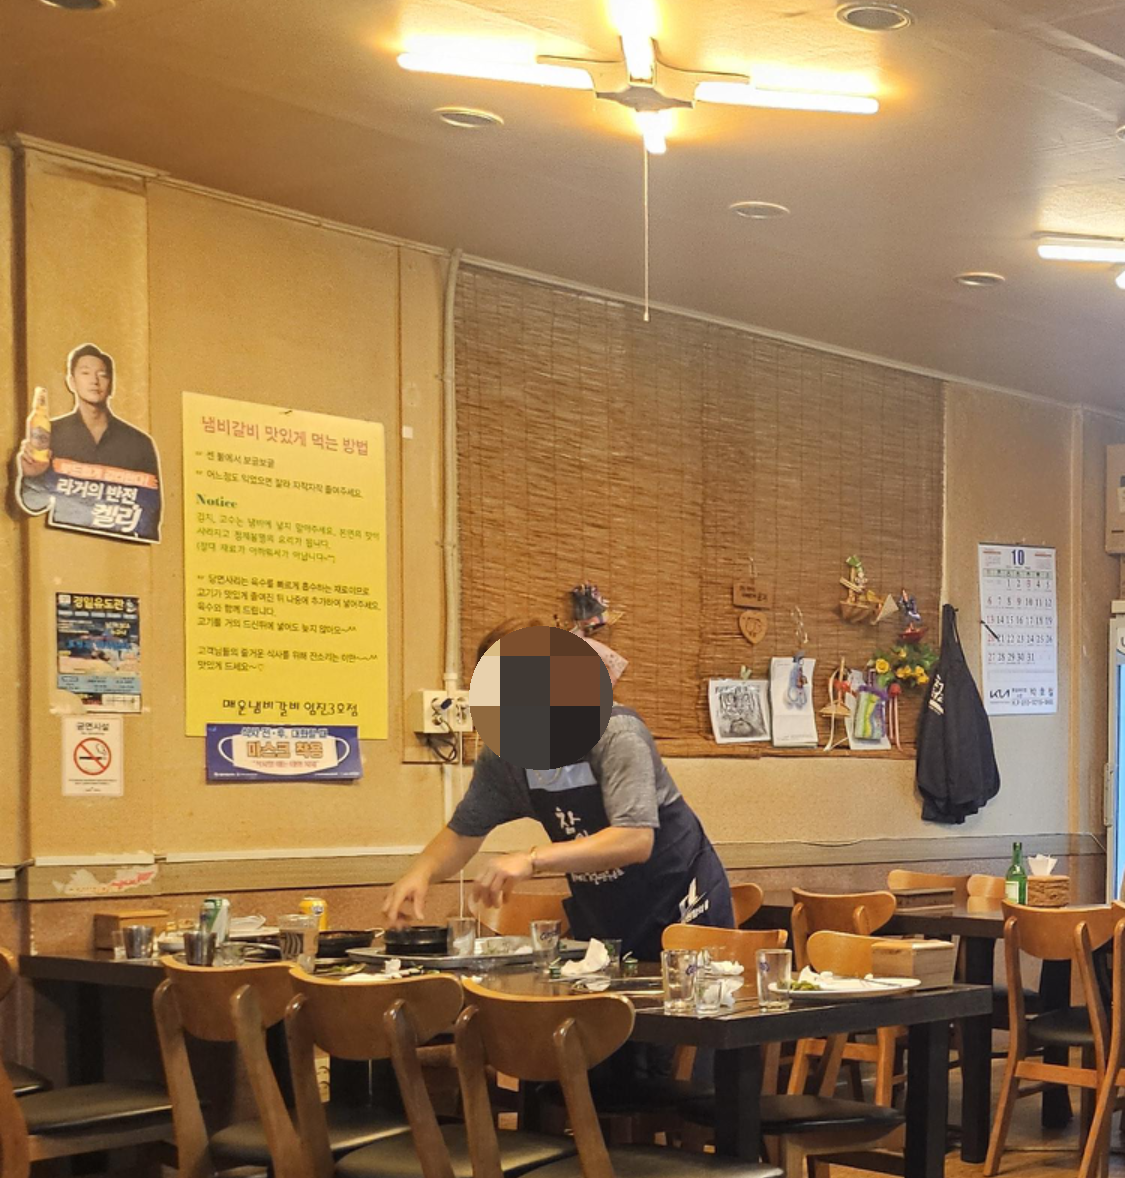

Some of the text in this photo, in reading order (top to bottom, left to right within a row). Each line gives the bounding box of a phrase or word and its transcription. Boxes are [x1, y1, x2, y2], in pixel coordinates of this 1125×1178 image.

[202, 416, 368, 456] 냄비갈비 맛있게 먹는 방법
[207, 469, 239, 482] 어느정도
[57, 478, 138, 505] 라거의 반전
[197, 493, 238, 508] Notice
[91, 503, 143, 532] 켈리
[1011, 549, 1025, 566] 10
[208, 574, 248, 586] 당면사리는
[247, 740, 323, 759] 마스크 착용
